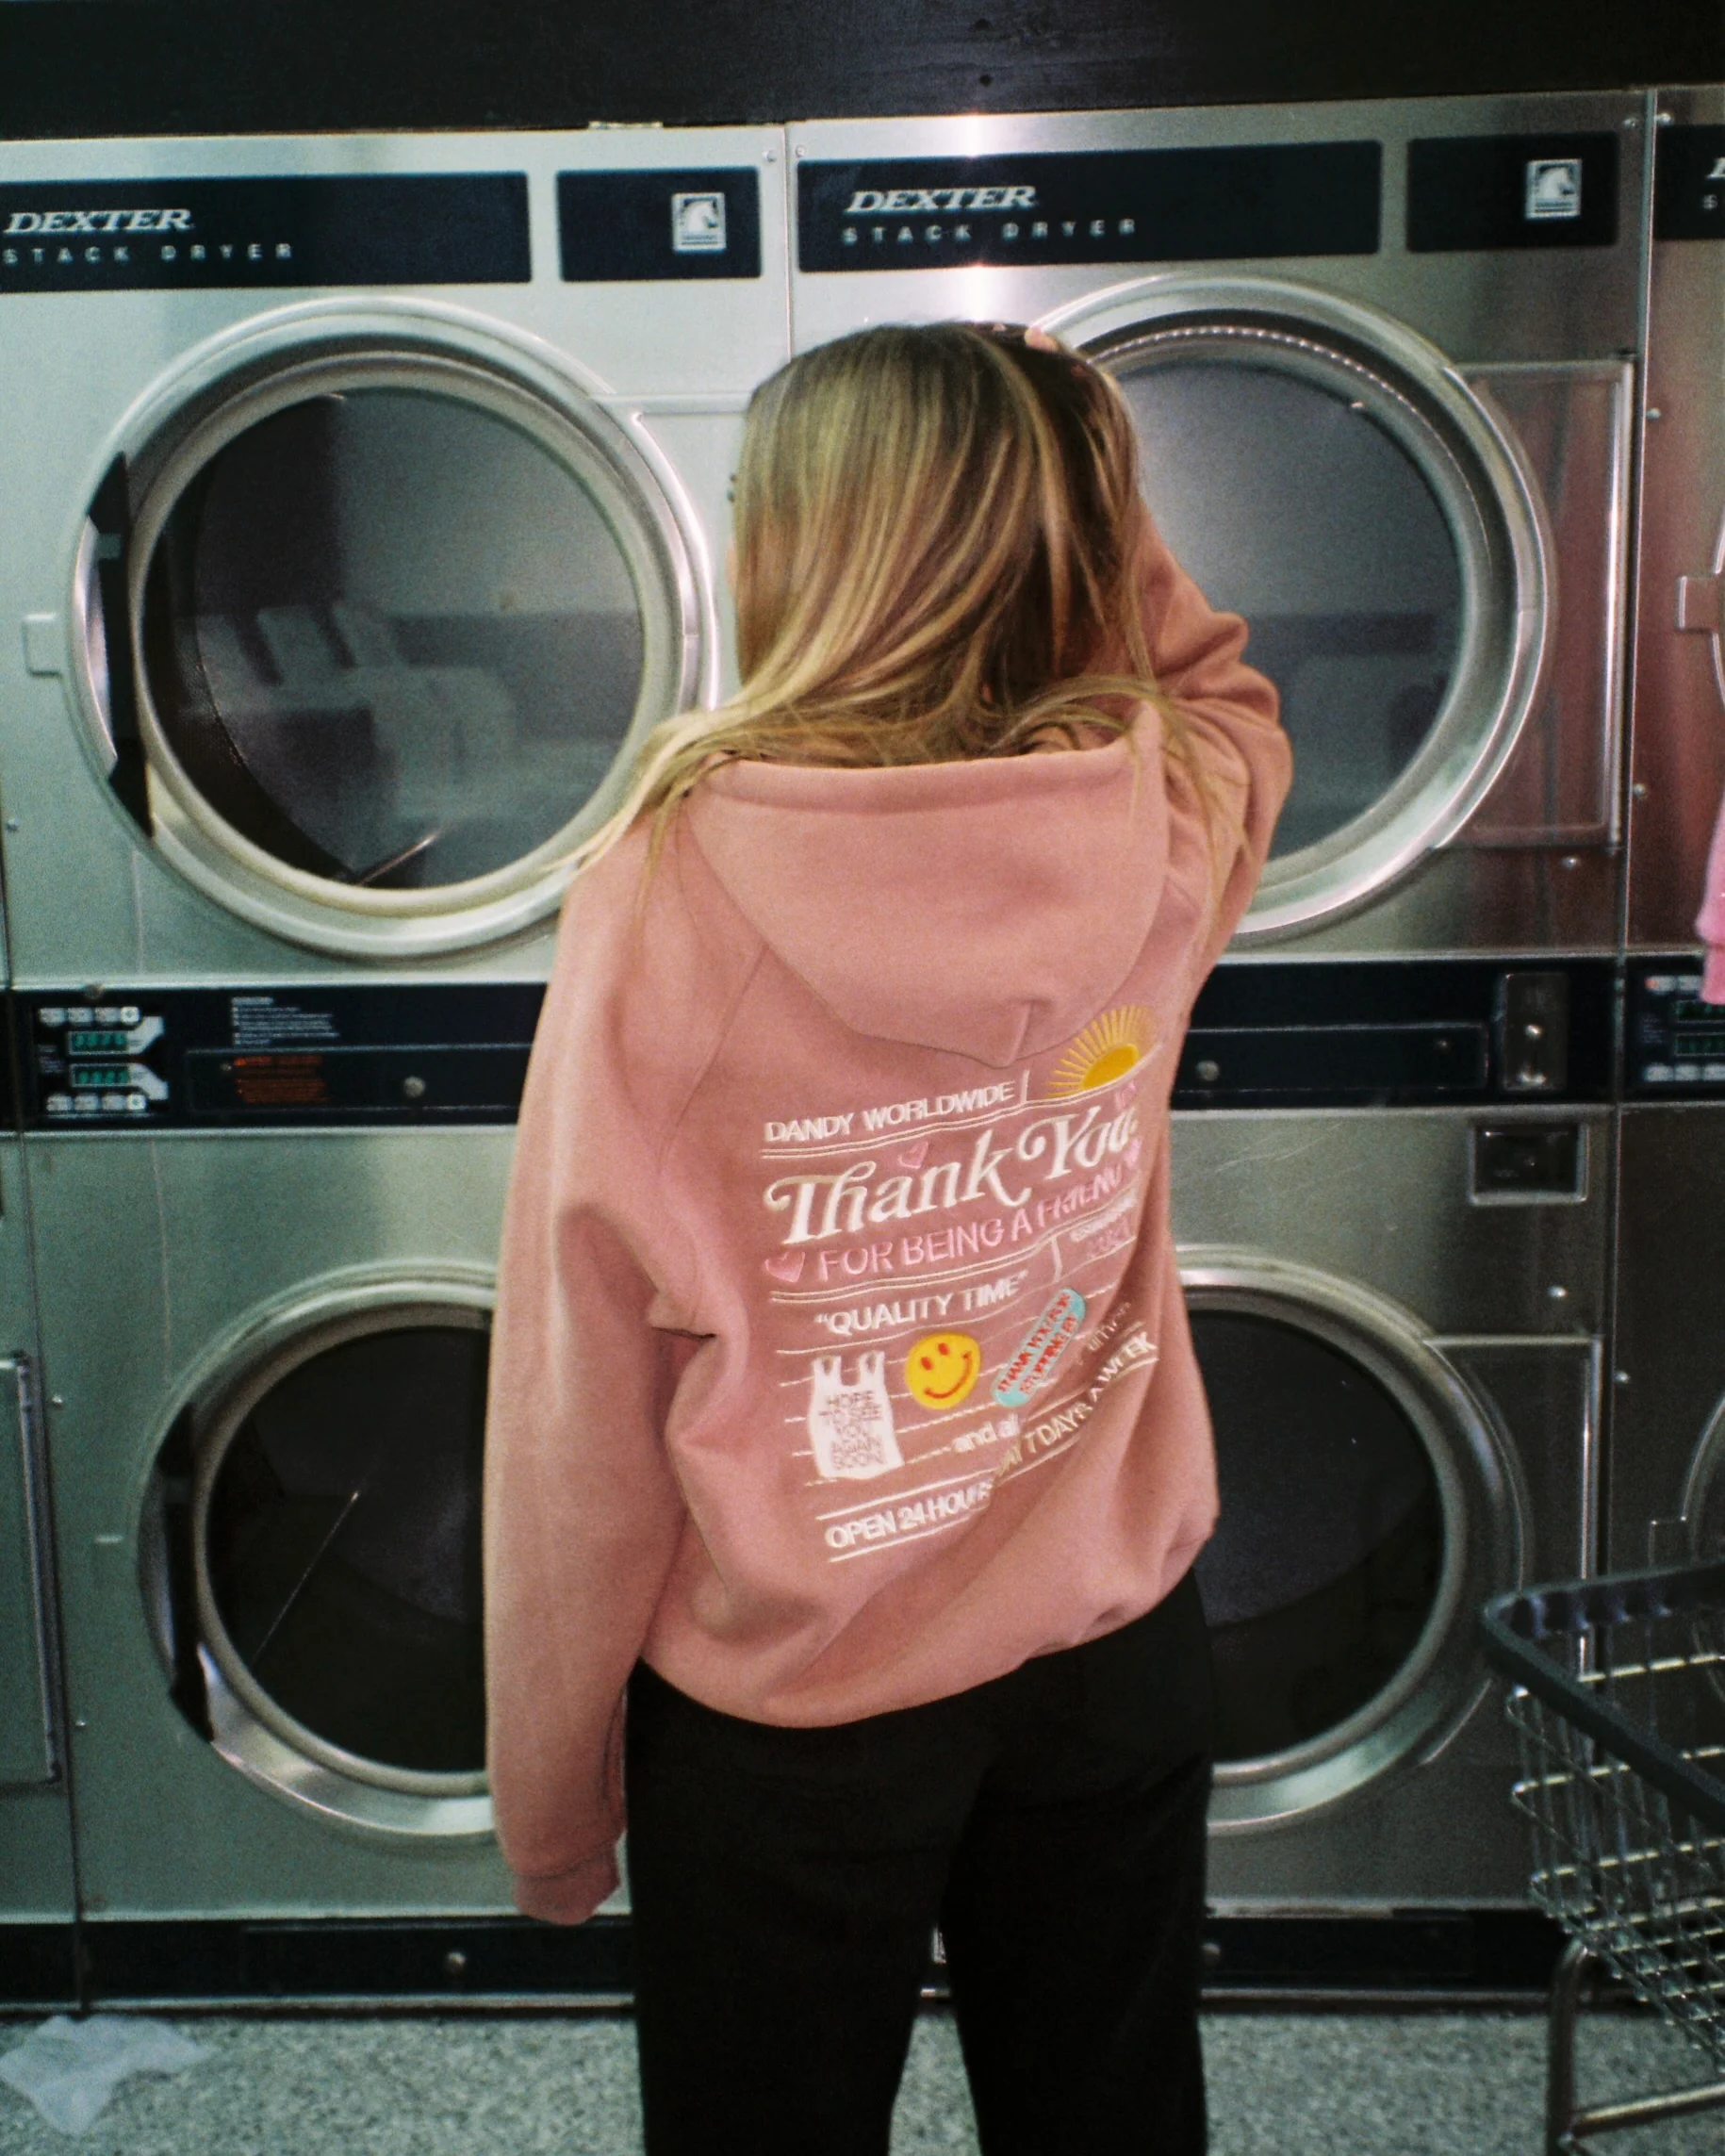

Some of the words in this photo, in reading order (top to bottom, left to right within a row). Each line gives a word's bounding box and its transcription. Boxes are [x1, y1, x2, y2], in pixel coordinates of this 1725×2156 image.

[846, 186, 1036, 213] DEXTER
[3, 208, 192, 235] DEXTER
[843, 224, 972, 244] STACK
[1002, 218, 1137, 241] DRYER
[2, 245, 130, 266] STACK
[160, 243, 293, 262] DRYER
[764, 1112, 855, 1142] DANDY
[862, 1080, 1015, 1130] WORLDWIDE
[764, 1129, 1032, 1244] Thank
[1018, 1105, 1139, 1180] You
[819, 1241, 894, 1282] FOR
[901, 1218, 1003, 1265] BEING
[1010, 1209, 1034, 1242] A
[951, 1422, 998, 1453] and
[825, 1510, 897, 1549] OPEN
[897, 1502, 927, 1531] 24
